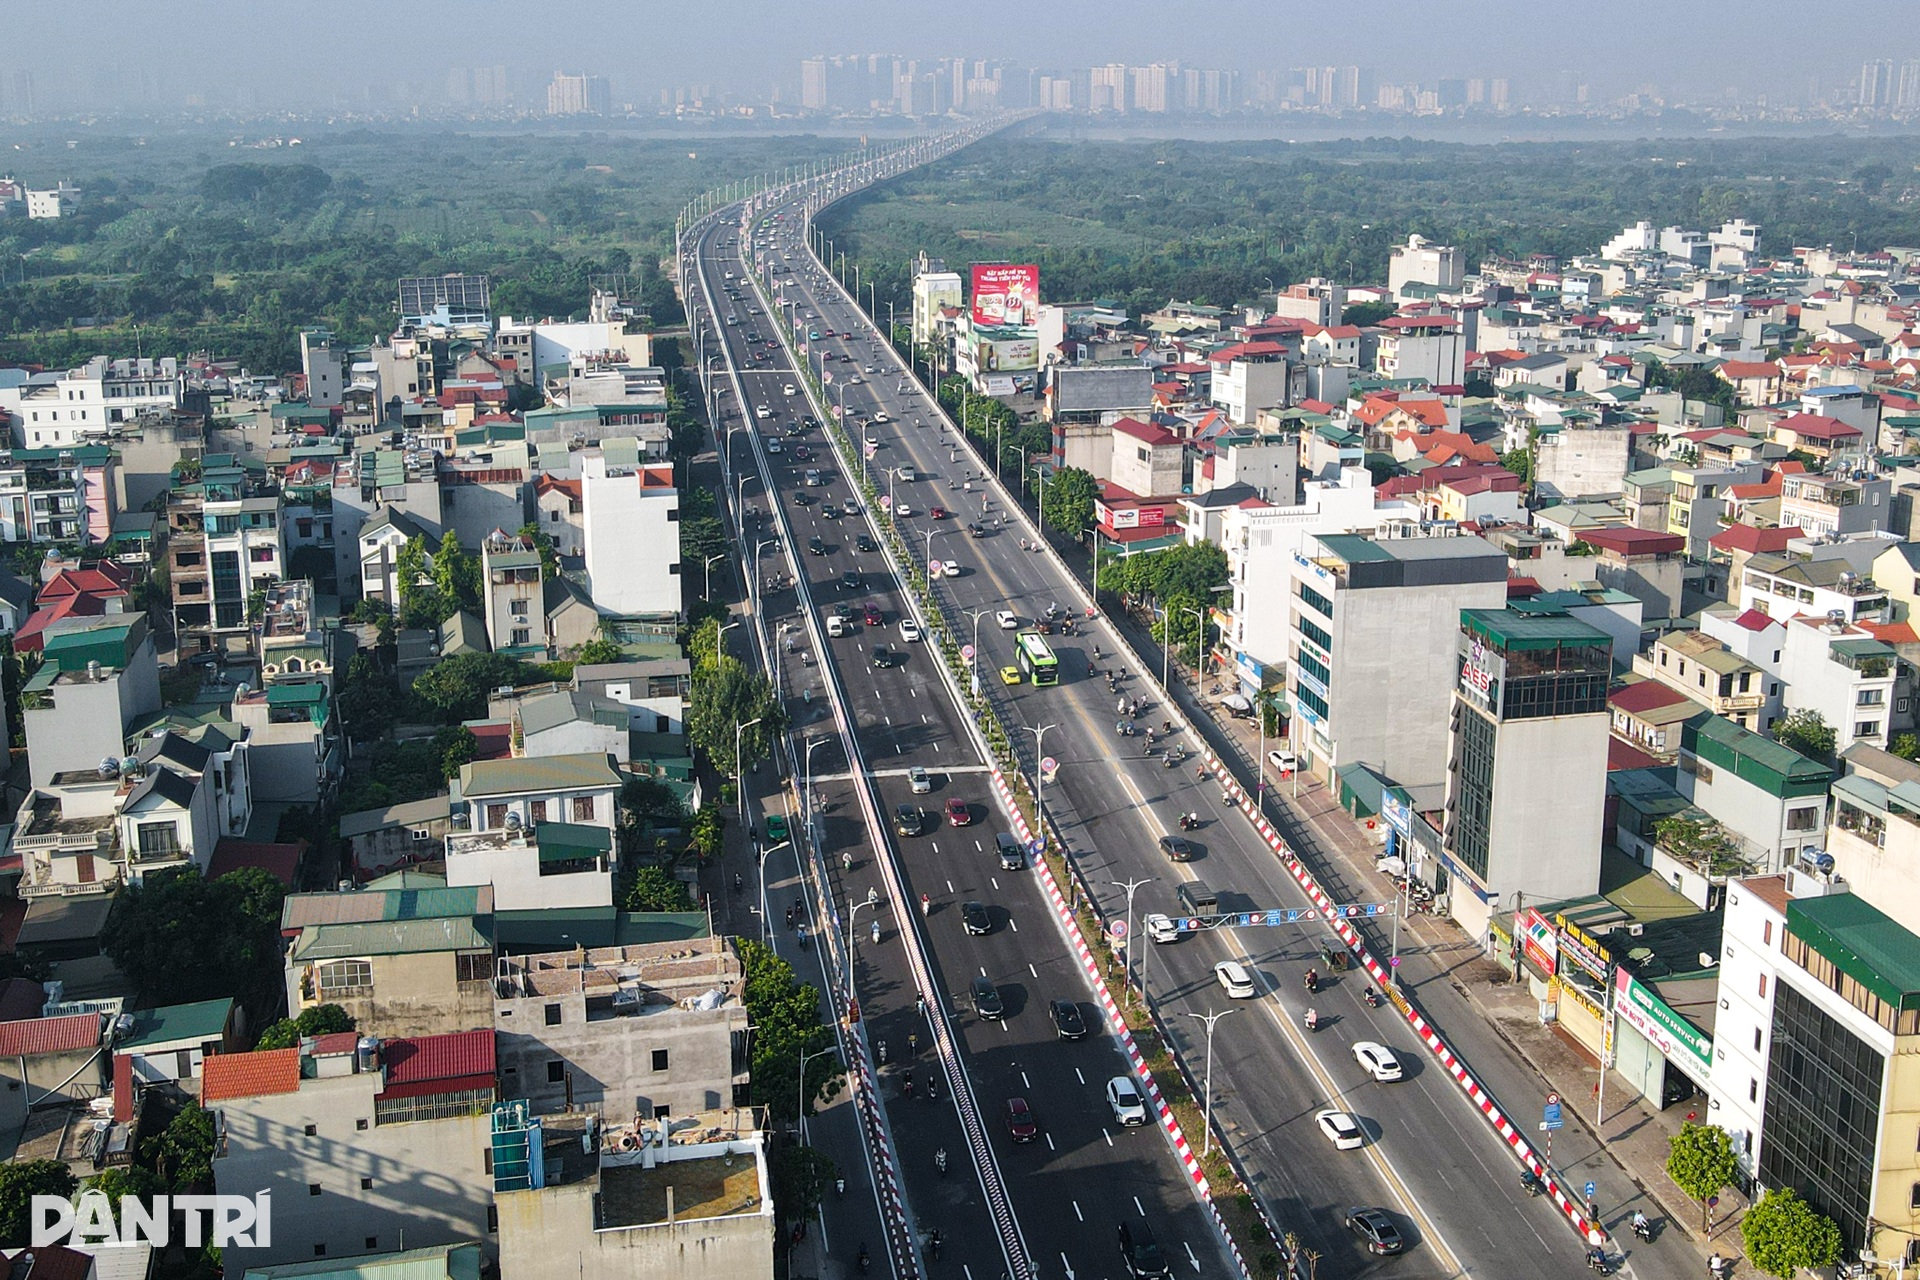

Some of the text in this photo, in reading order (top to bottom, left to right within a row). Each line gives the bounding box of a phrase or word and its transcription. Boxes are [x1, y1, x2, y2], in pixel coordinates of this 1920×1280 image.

[1462, 662, 1489, 692] AES
[1653, 1007, 1670, 1023] AUTO
[1669, 1020, 1696, 1046] SERVICE
